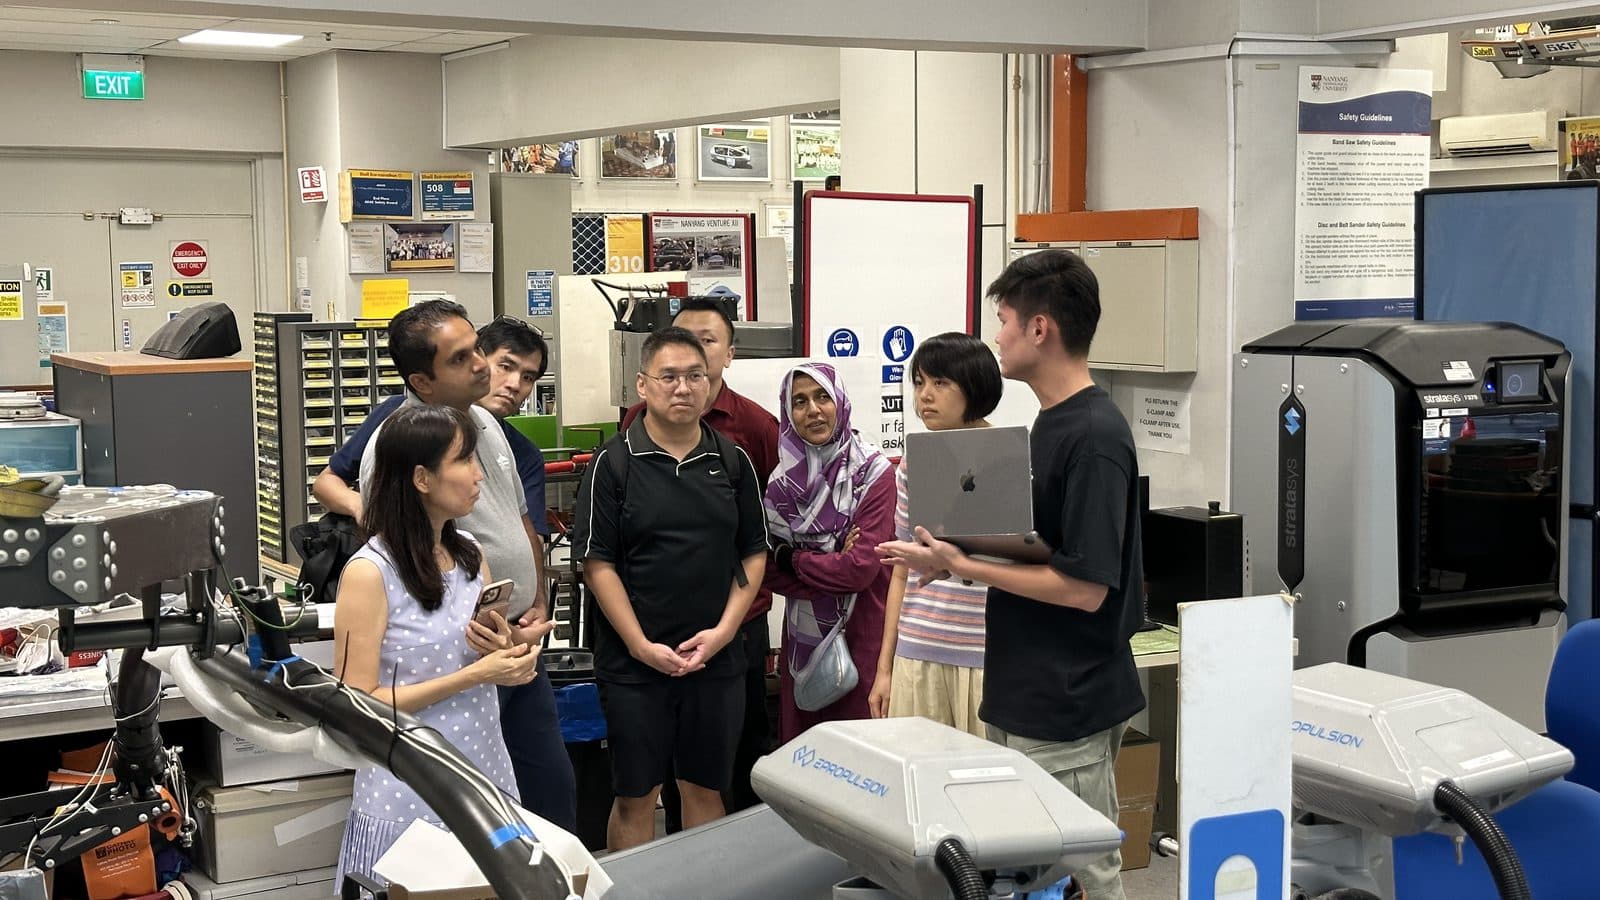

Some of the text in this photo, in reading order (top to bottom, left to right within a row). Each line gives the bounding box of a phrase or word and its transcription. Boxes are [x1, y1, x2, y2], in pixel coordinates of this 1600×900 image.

[1474, 46, 1494, 56] Sabelt
[1546, 42, 1577, 54] SKF
[95, 76, 131, 94] EXIT
[1339, 112, 1392, 122] Safety Guidelines
[426, 184, 444, 192] 508
[680, 220, 706, 228] NANYANG
[706, 219, 730, 228] VENTURE
[608, 256, 642, 273] 310
[1424, 394, 1461, 404] stratasys
[1286, 458, 1300, 549] stratasys
[813, 758, 889, 797] EPROPULSION
